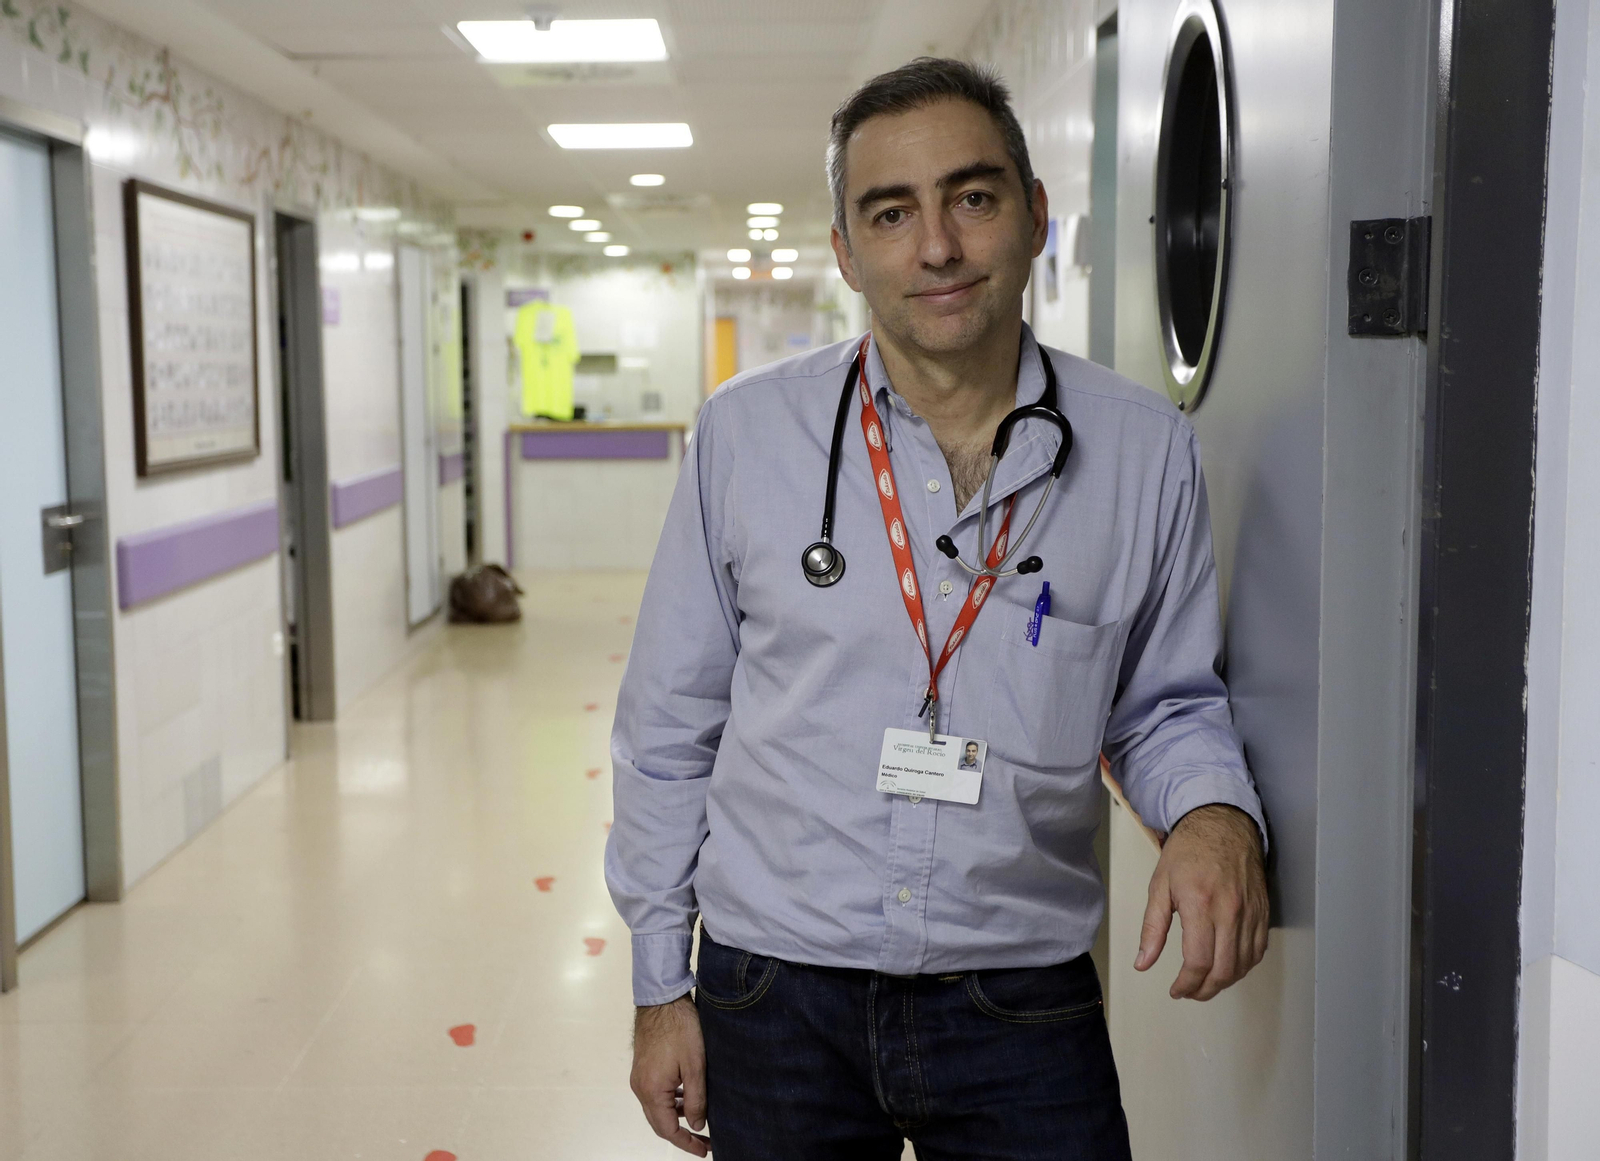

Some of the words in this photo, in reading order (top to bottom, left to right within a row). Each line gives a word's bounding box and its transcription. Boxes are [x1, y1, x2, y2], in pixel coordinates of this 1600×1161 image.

[882, 474, 891, 494] Takeda
[894, 523, 902, 543] Takeda
[906, 573, 914, 594] Takeda
[974, 583, 987, 603] Takeda
[893, 744, 914, 754] Virgen
[915, 747, 925, 755] del
[903, 767, 924, 775] Quiroga
[924, 769, 944, 777] Cantero
